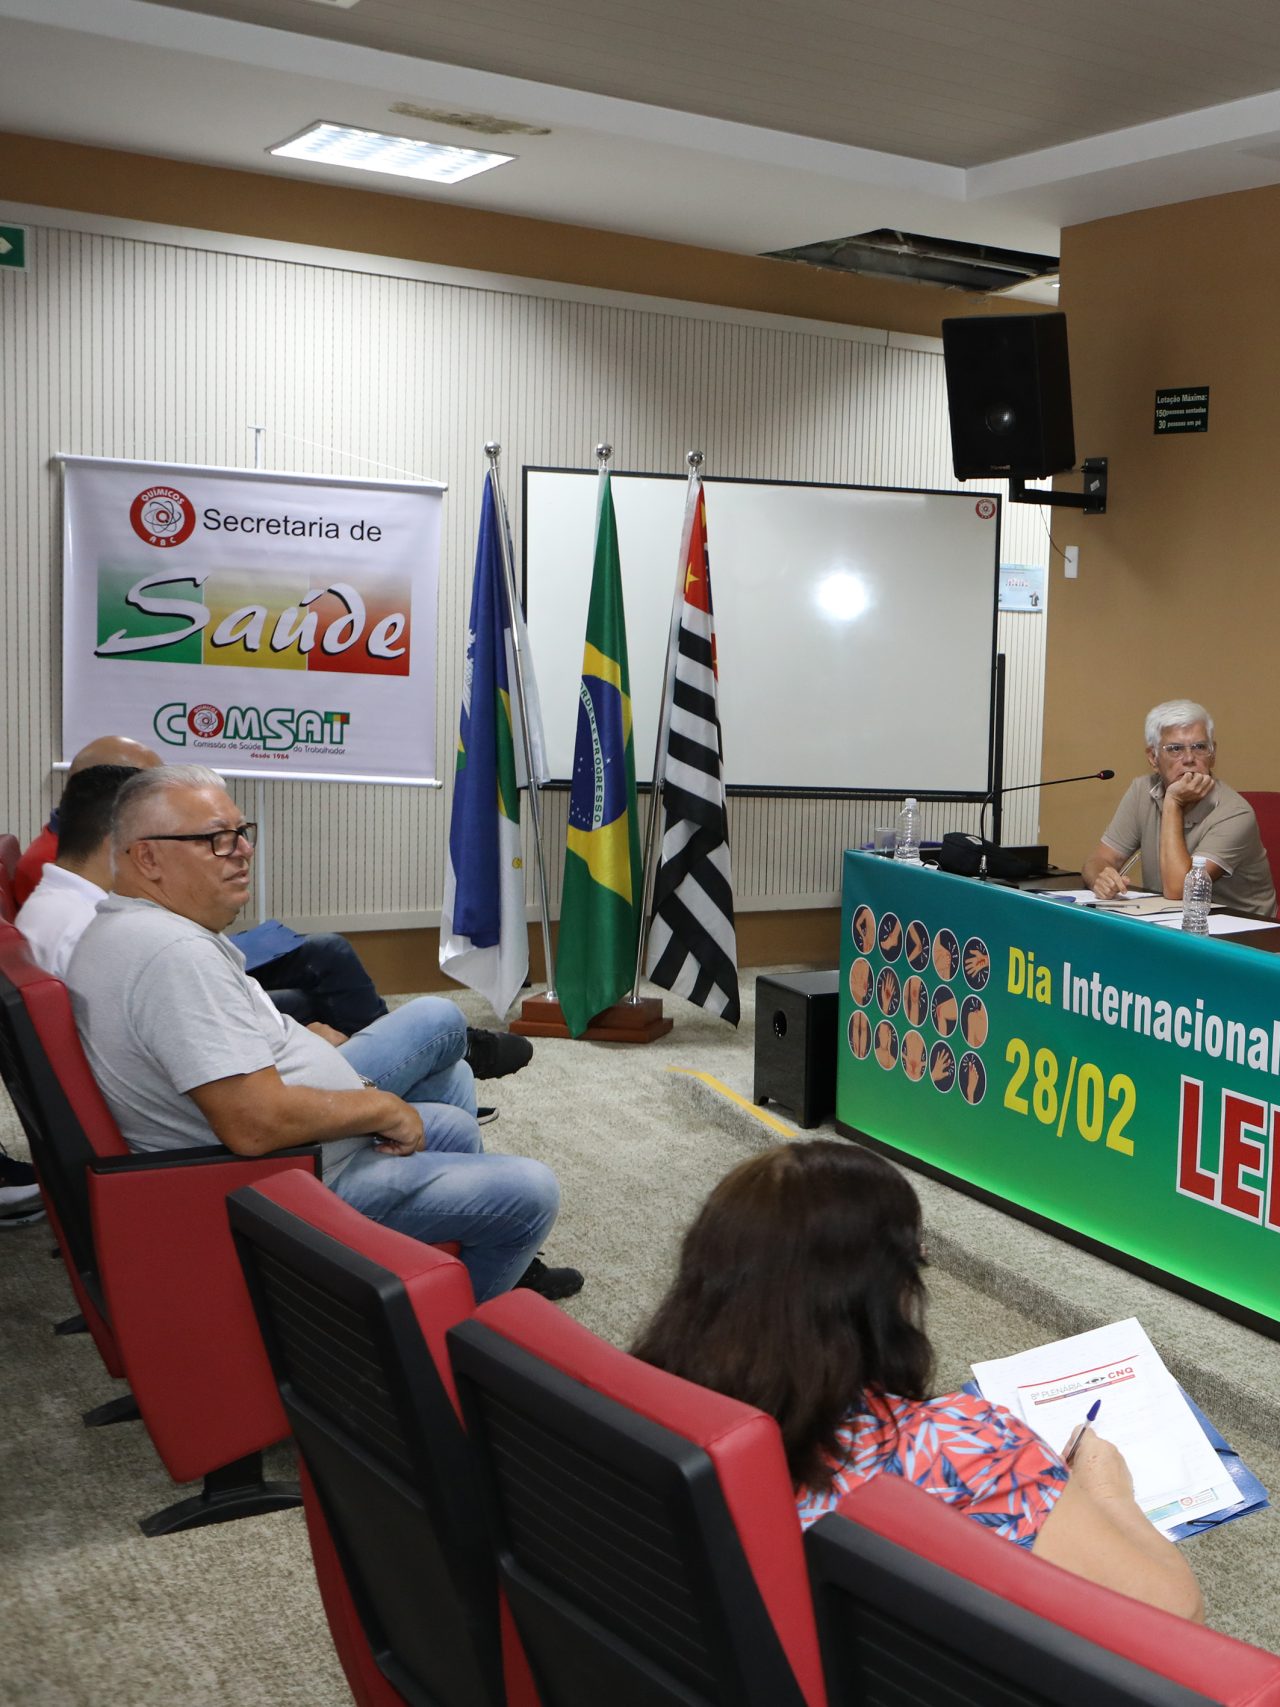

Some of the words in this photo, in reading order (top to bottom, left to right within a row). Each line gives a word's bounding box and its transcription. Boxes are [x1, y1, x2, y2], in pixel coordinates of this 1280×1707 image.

[1156, 409, 1167, 418] 150
[1158, 420, 1166, 429] 30
[203, 508, 340, 539] Secretaria
[350, 520, 382, 542] de
[94, 567, 406, 660] Saúde
[193, 740, 227, 749] Comissão
[228, 740, 239, 749] de
[240, 741, 262, 750] Saúde
[304, 745, 346, 755] Trabalhador
[593, 738, 604, 823] PROGRESSO
[1007, 946, 1052, 1005] Dia
[1003, 1037, 1137, 1157] 28/02
[1041, 1382, 1083, 1398] PLENÁRIA
[1108, 1367, 1134, 1379] CNQ
